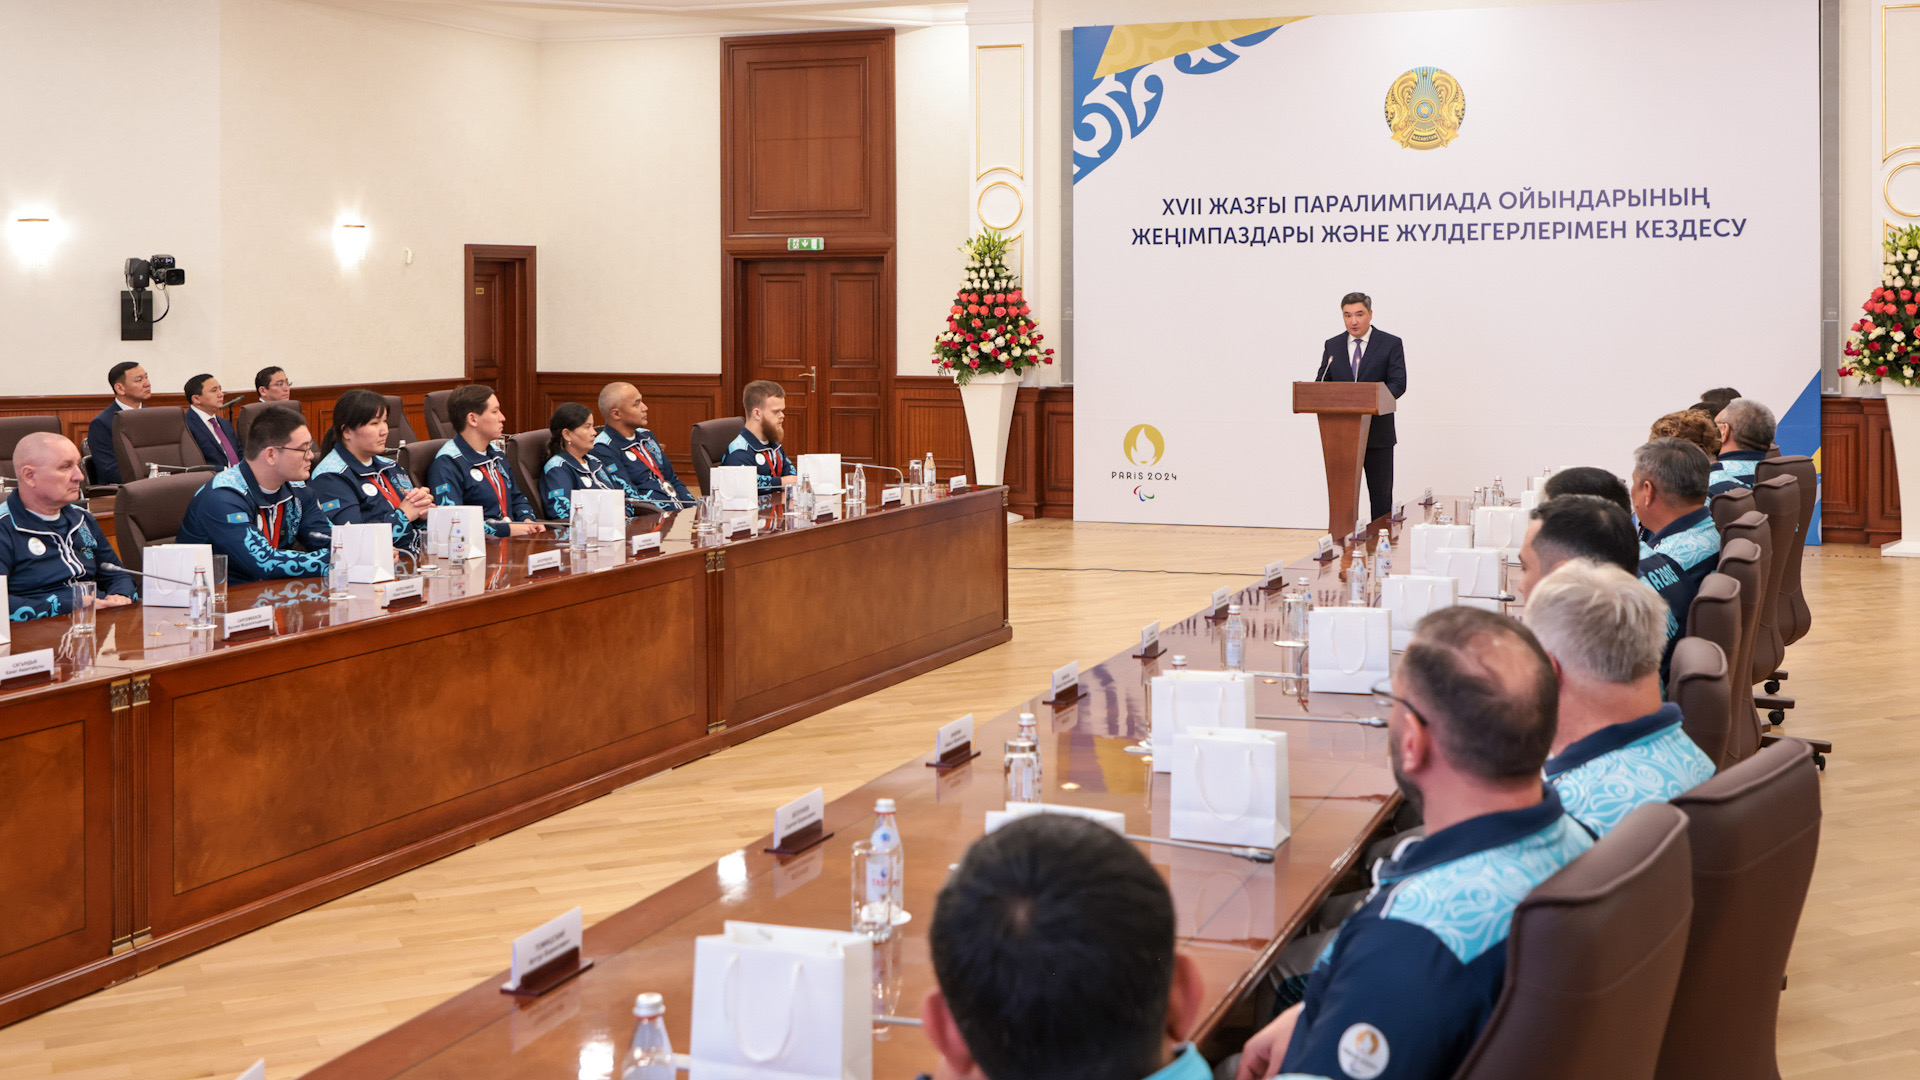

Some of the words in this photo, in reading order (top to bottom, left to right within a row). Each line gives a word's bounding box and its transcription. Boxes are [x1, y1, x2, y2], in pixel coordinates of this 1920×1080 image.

[1162, 198, 1201, 215] XVII
[1209, 197, 1285, 214] ЖАЗҒЫ
[1295, 192, 1491, 213] ПАРАЛИМПИАДА
[1499, 187, 1710, 211] ОЙЫНДАРЫНЫҢ
[1132, 226, 1313, 247] ЖЕҢІМПАЗДАРЫ
[1322, 225, 1389, 242] ЖӘНЕ
[1396, 221, 1626, 244] ЖҮЛДЕГЕРЛЕРІМЕН
[1636, 219, 1746, 241] КЕЗДЕСУ
